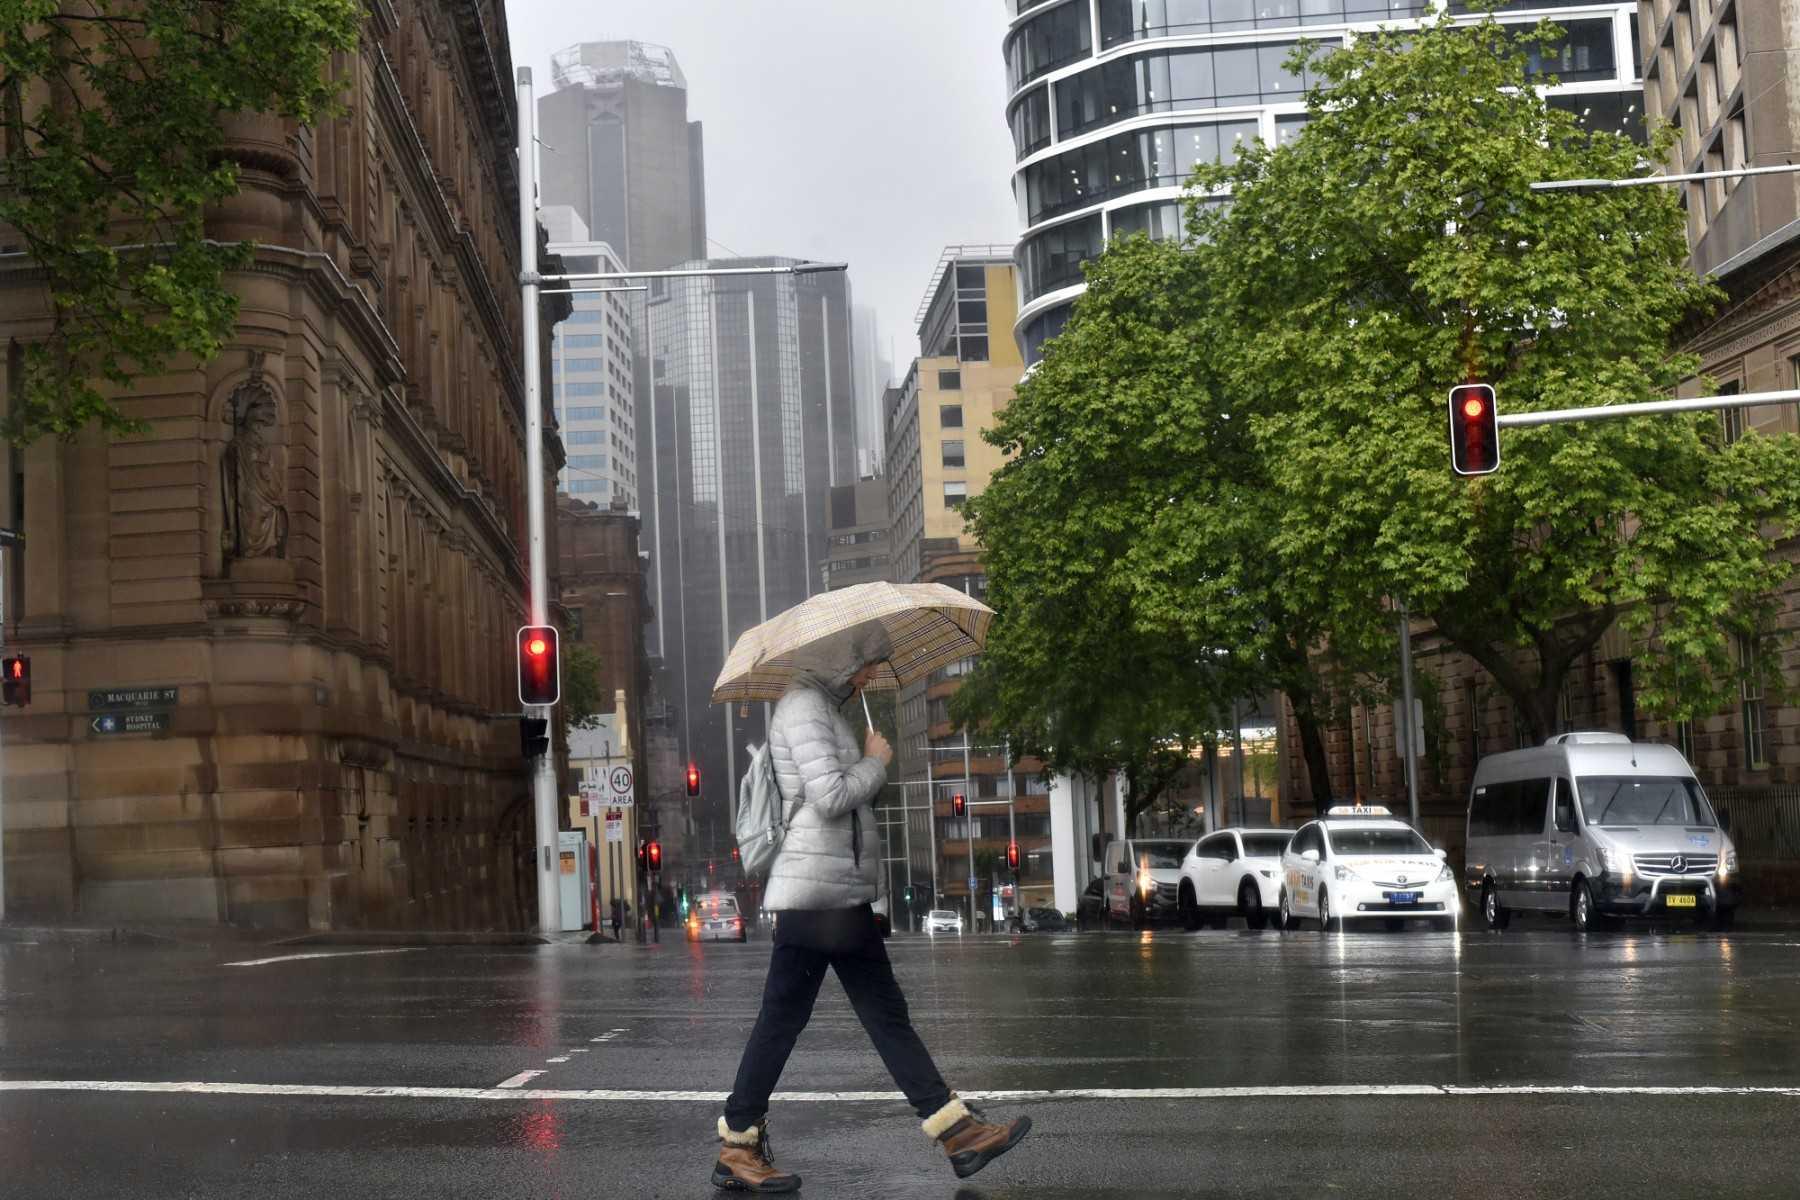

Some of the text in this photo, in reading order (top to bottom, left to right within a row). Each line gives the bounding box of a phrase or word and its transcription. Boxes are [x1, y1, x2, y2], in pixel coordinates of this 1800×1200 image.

[107, 689, 176, 703] MACQUARIE ST
[125, 715, 153, 723] SYDNEY
[125, 721, 160, 731] HOSPITAL
[614, 773, 630, 787] 40
[612, 795, 633, 805] AREA
